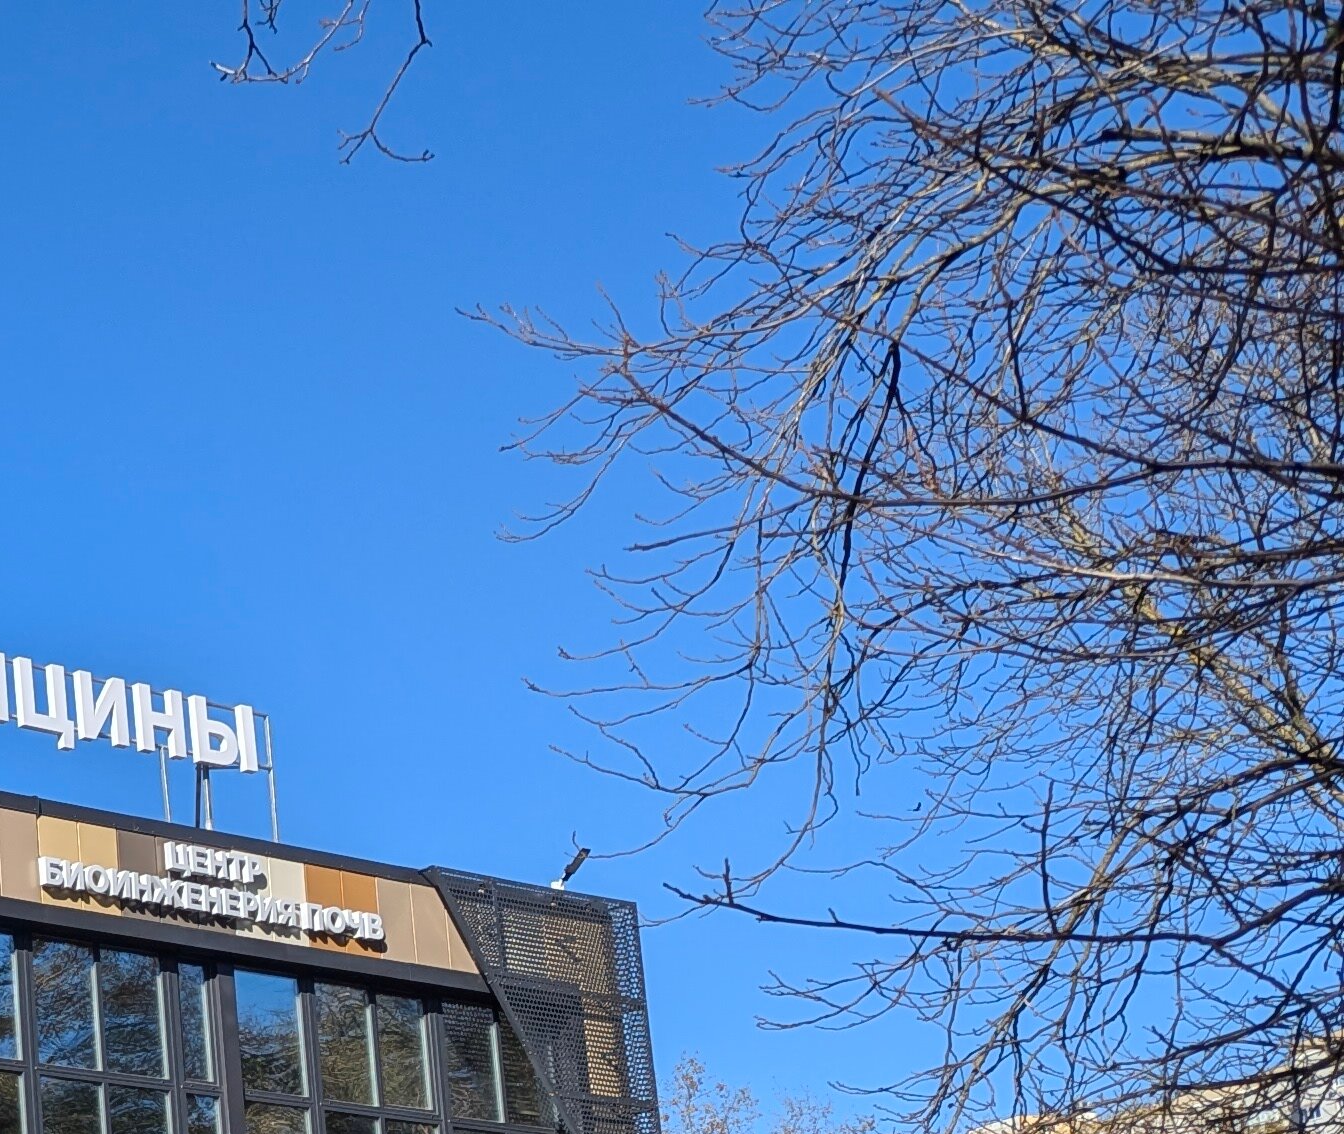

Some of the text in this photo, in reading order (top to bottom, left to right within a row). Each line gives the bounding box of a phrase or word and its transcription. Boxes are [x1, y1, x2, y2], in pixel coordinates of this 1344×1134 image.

[164, 841, 264, 884] ЦЕНТР
[37, 855, 385, 941] БИОИНЖЕНЕРИЯ ПОЧВ
